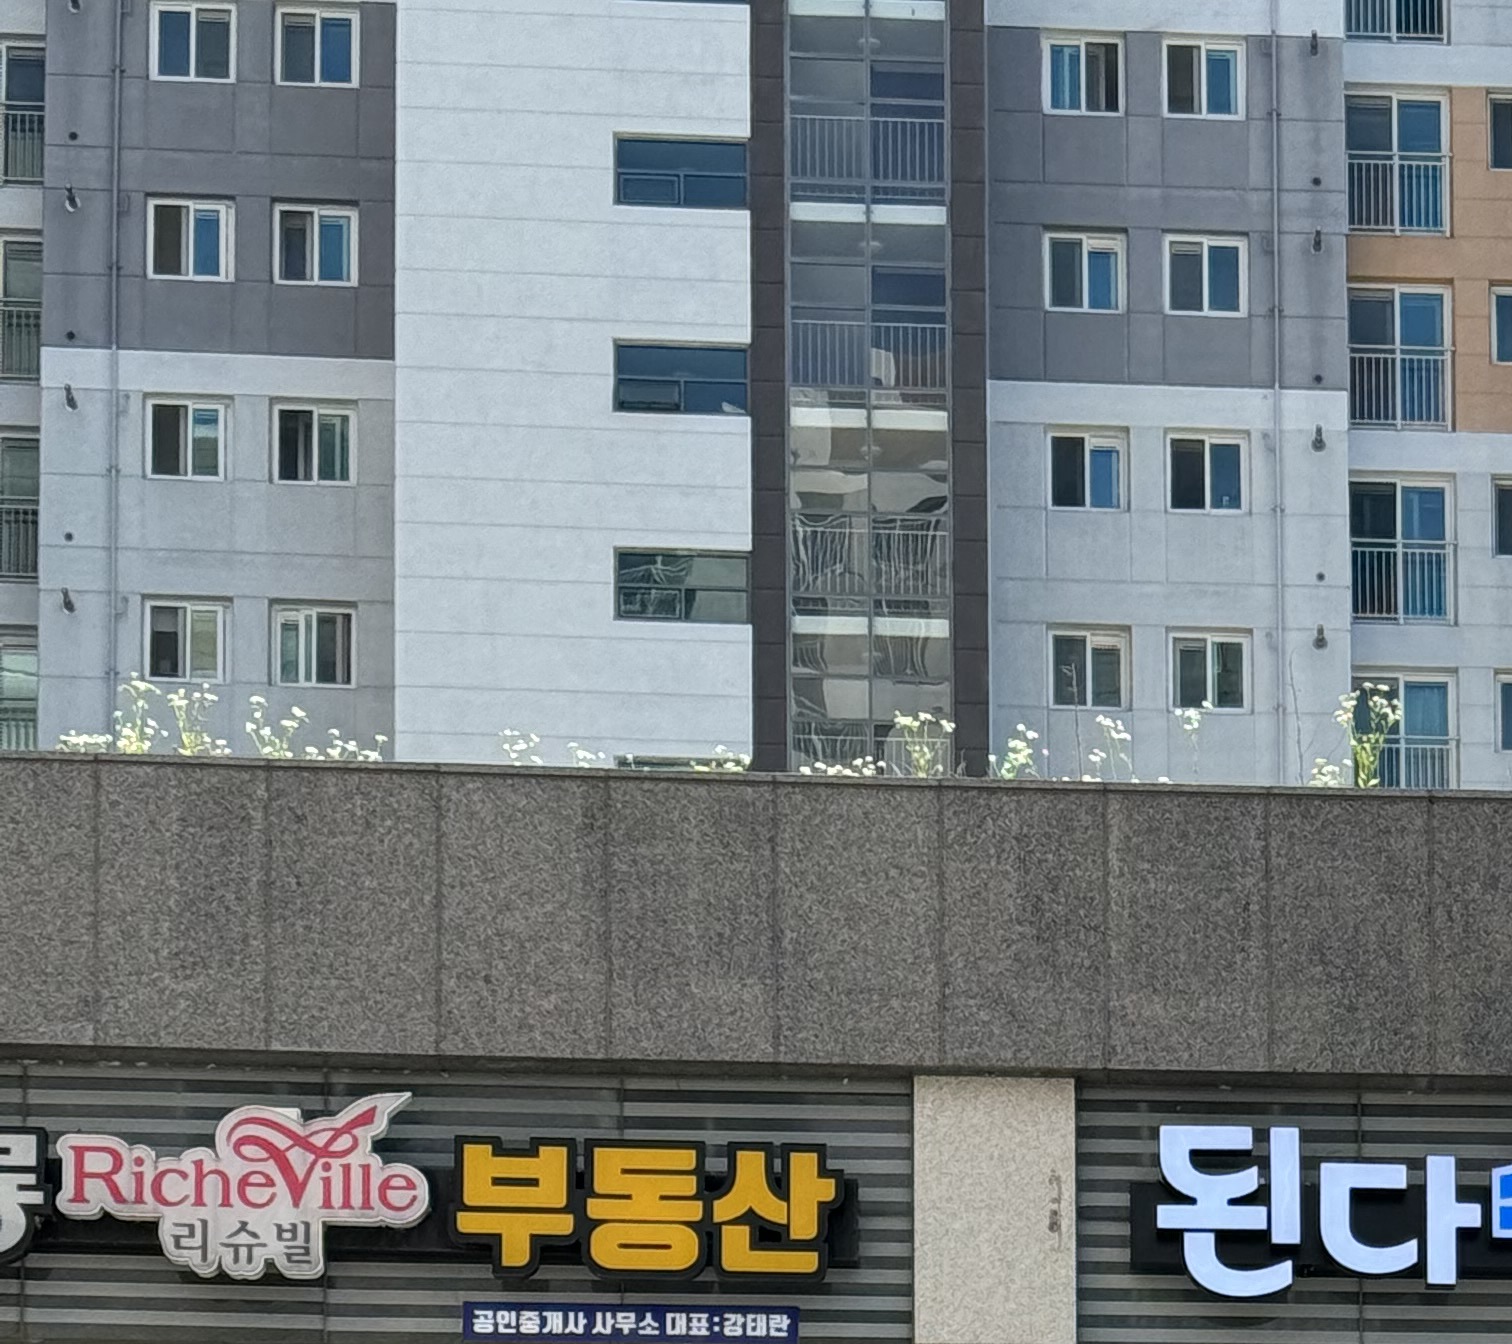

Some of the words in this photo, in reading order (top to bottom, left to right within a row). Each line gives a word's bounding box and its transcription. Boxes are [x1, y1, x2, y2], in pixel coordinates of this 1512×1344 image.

[67, 1106, 418, 1213] RicheVille
[456, 1143, 837, 1273] 부동산
[1156, 1125, 1481, 1298] 된다
[171, 1219, 312, 1264] 리슈빌
[472, 1309, 586, 1335] 공인중개사
[591, 1310, 659, 1336] 사무소
[665, 1311, 791, 1338] 대표:강태란
